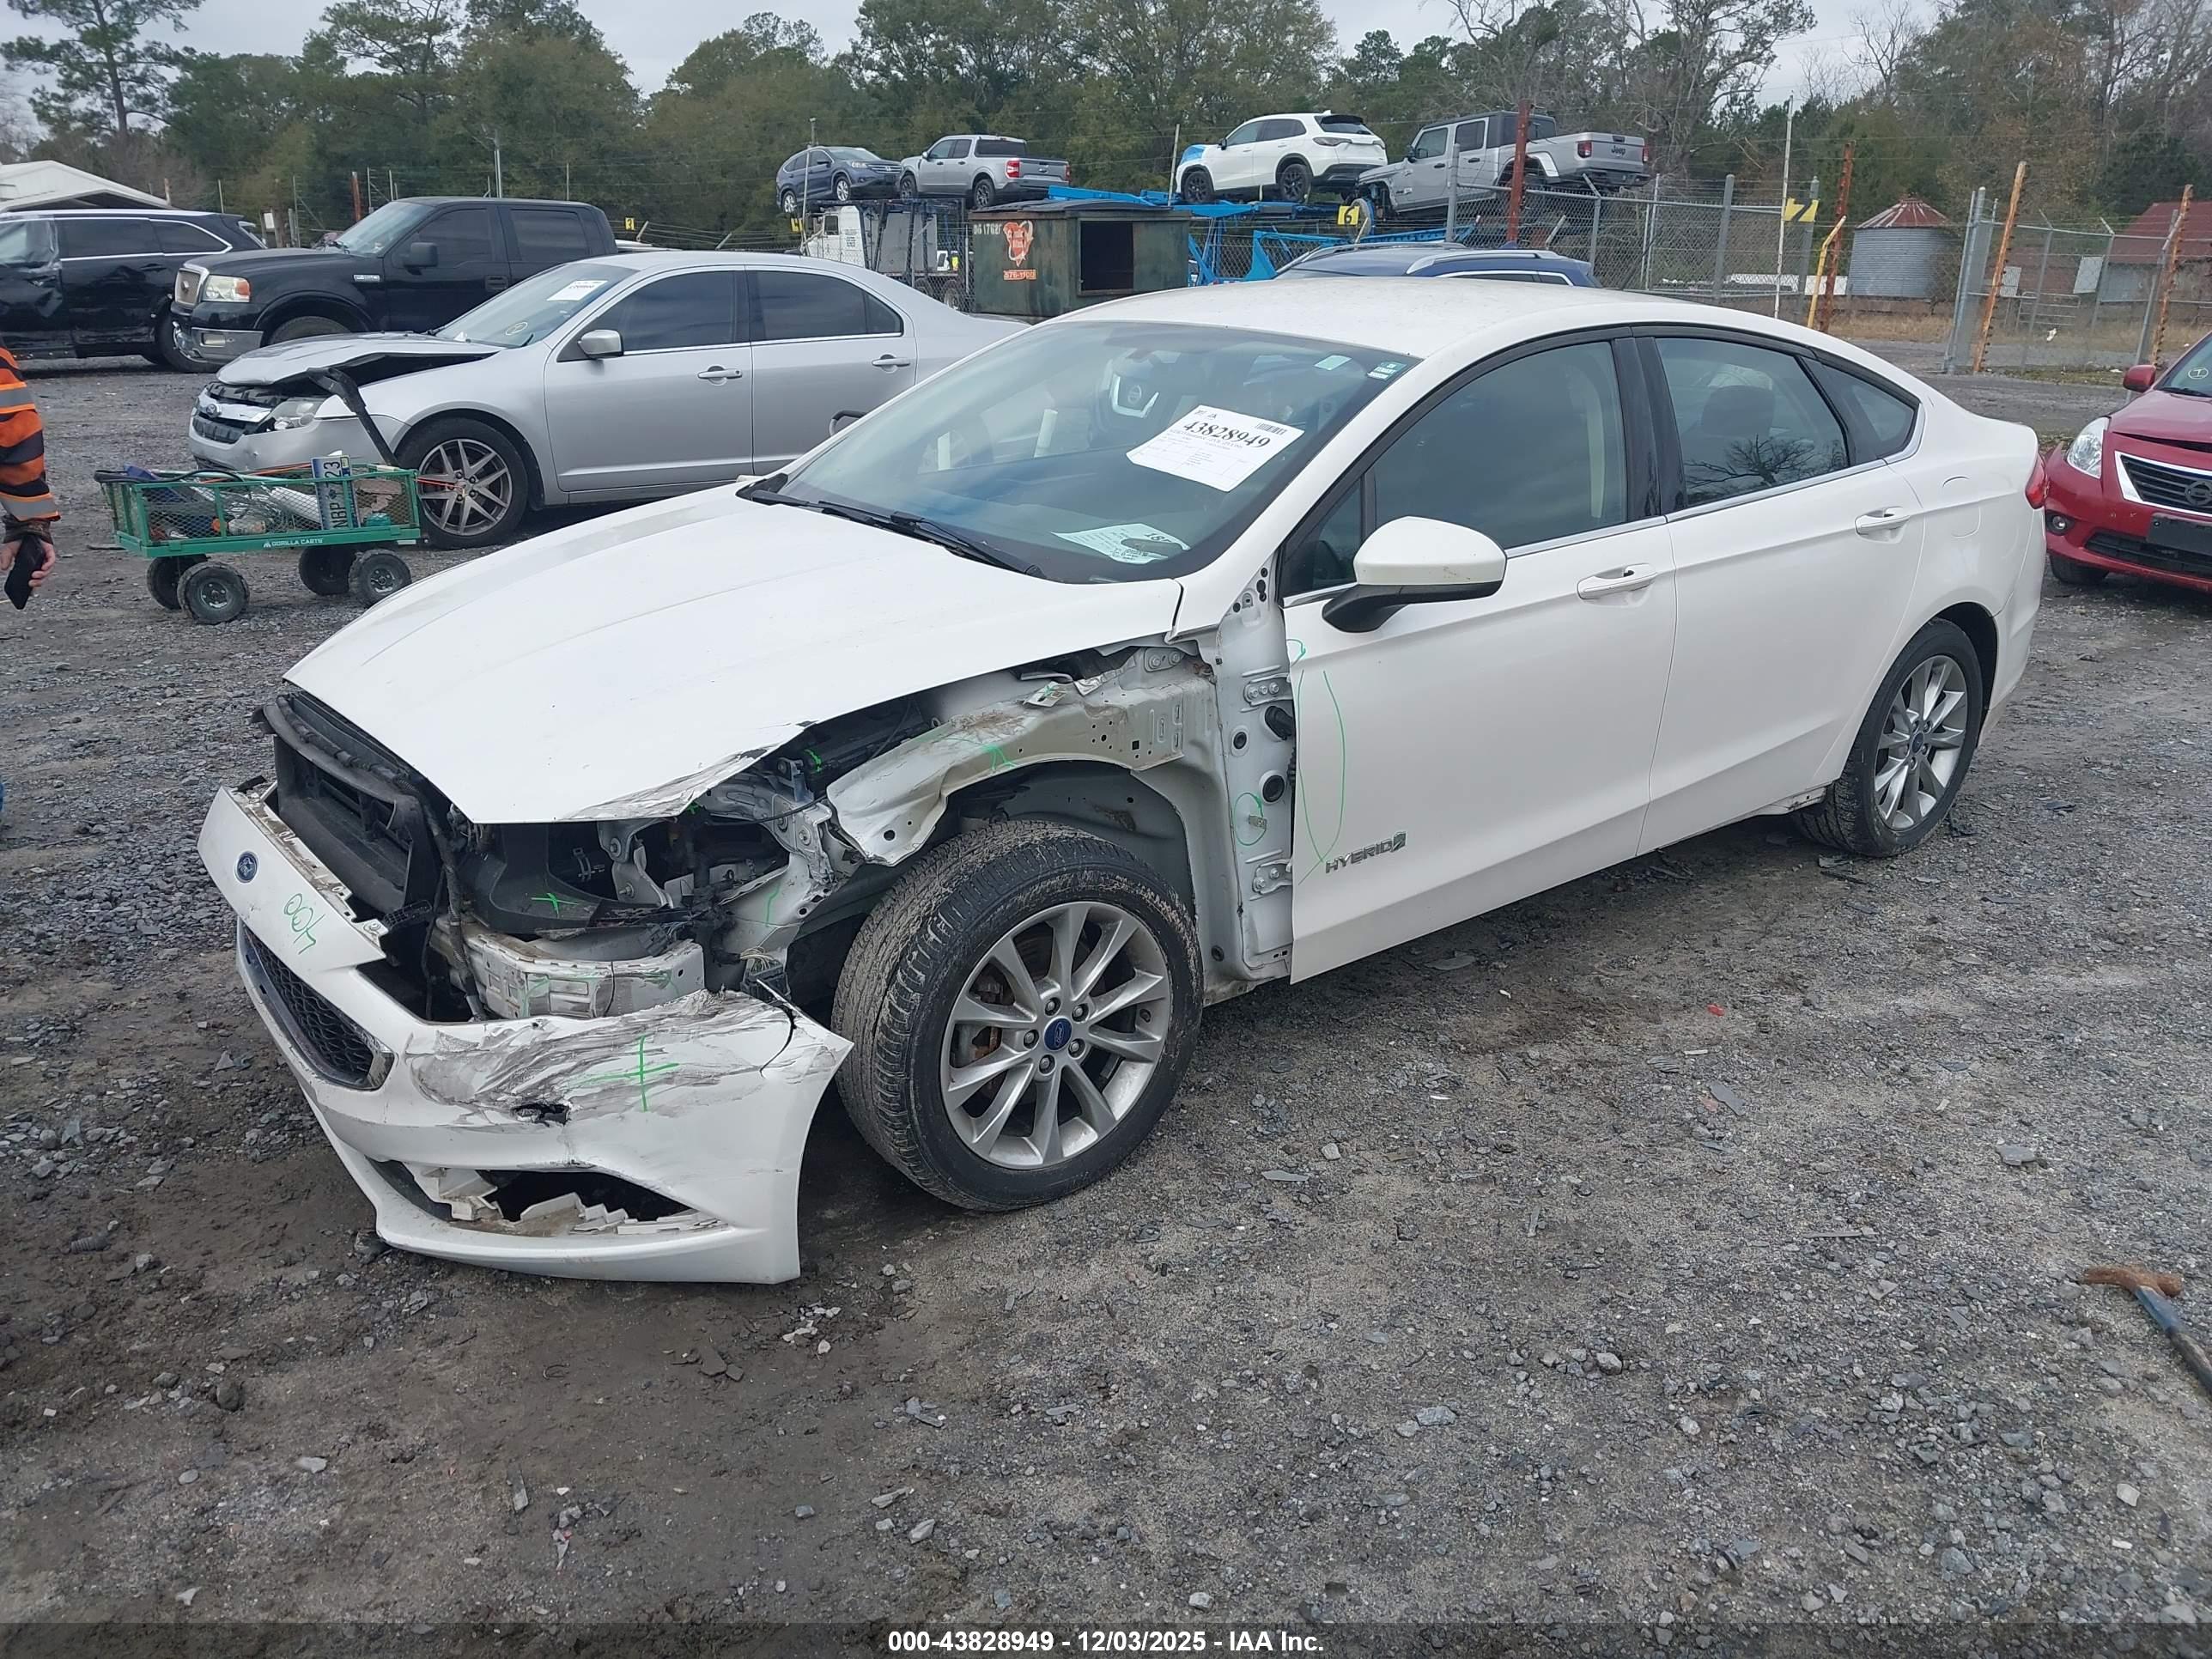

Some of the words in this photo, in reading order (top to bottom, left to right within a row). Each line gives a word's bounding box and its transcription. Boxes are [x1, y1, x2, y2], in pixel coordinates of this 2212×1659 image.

[1611, 145, 1626, 155] Jeep
[1344, 206, 1355, 226] 6
[1183, 421, 1271, 448] 43828949
[1325, 838, 1393, 874] HYBRID
